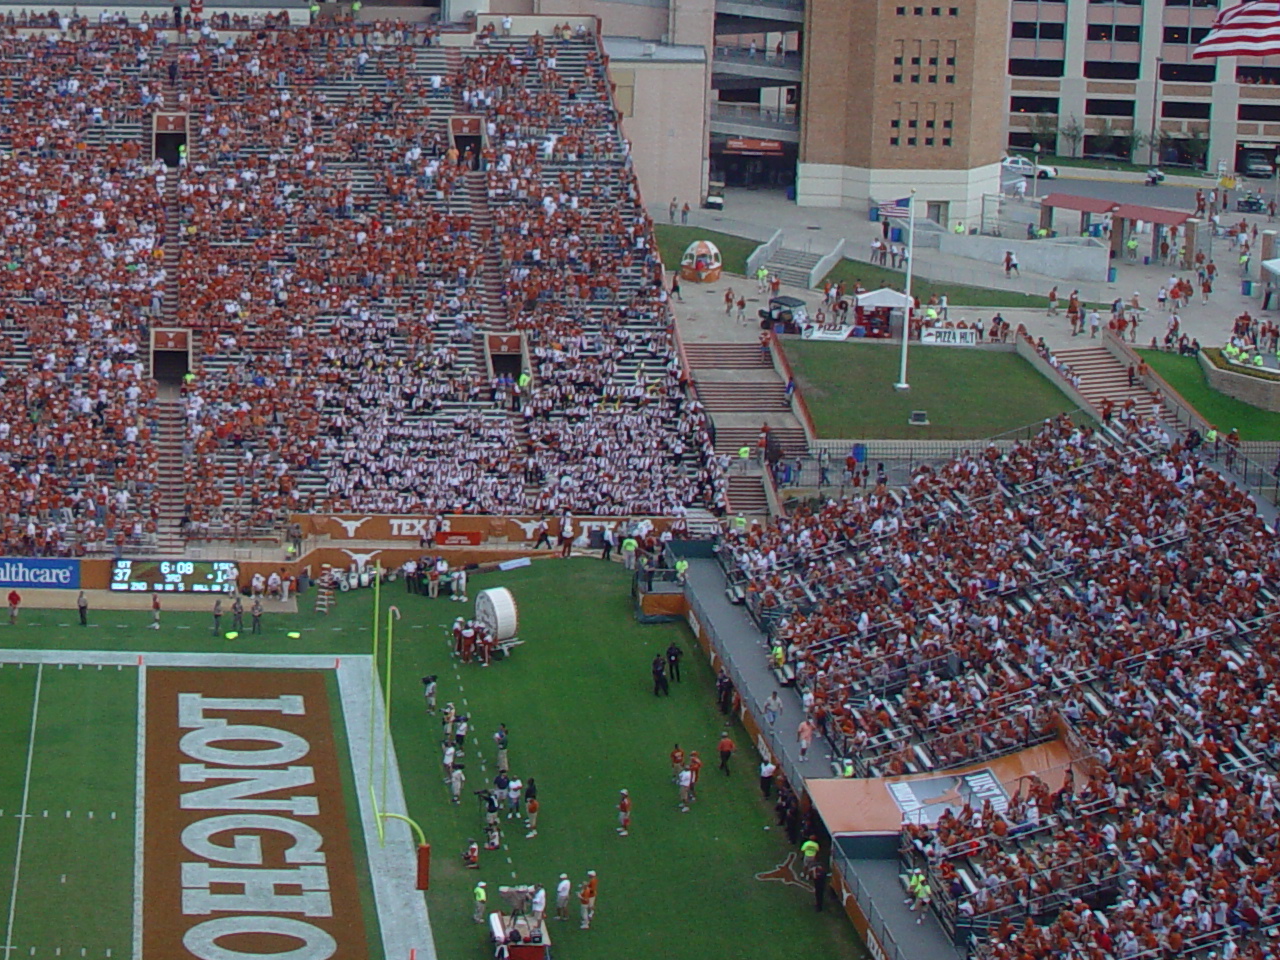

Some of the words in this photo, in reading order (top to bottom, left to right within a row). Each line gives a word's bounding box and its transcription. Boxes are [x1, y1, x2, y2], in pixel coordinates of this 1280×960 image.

[934, 330, 957, 343] PIZZA
[959, 331, 975, 344] HUT
[160, 561, 194, 574] 6:08
[114, 569, 131, 581] 37
[965, 773, 1002, 797] JUST
[178, 692, 337, 960] LONGHO
